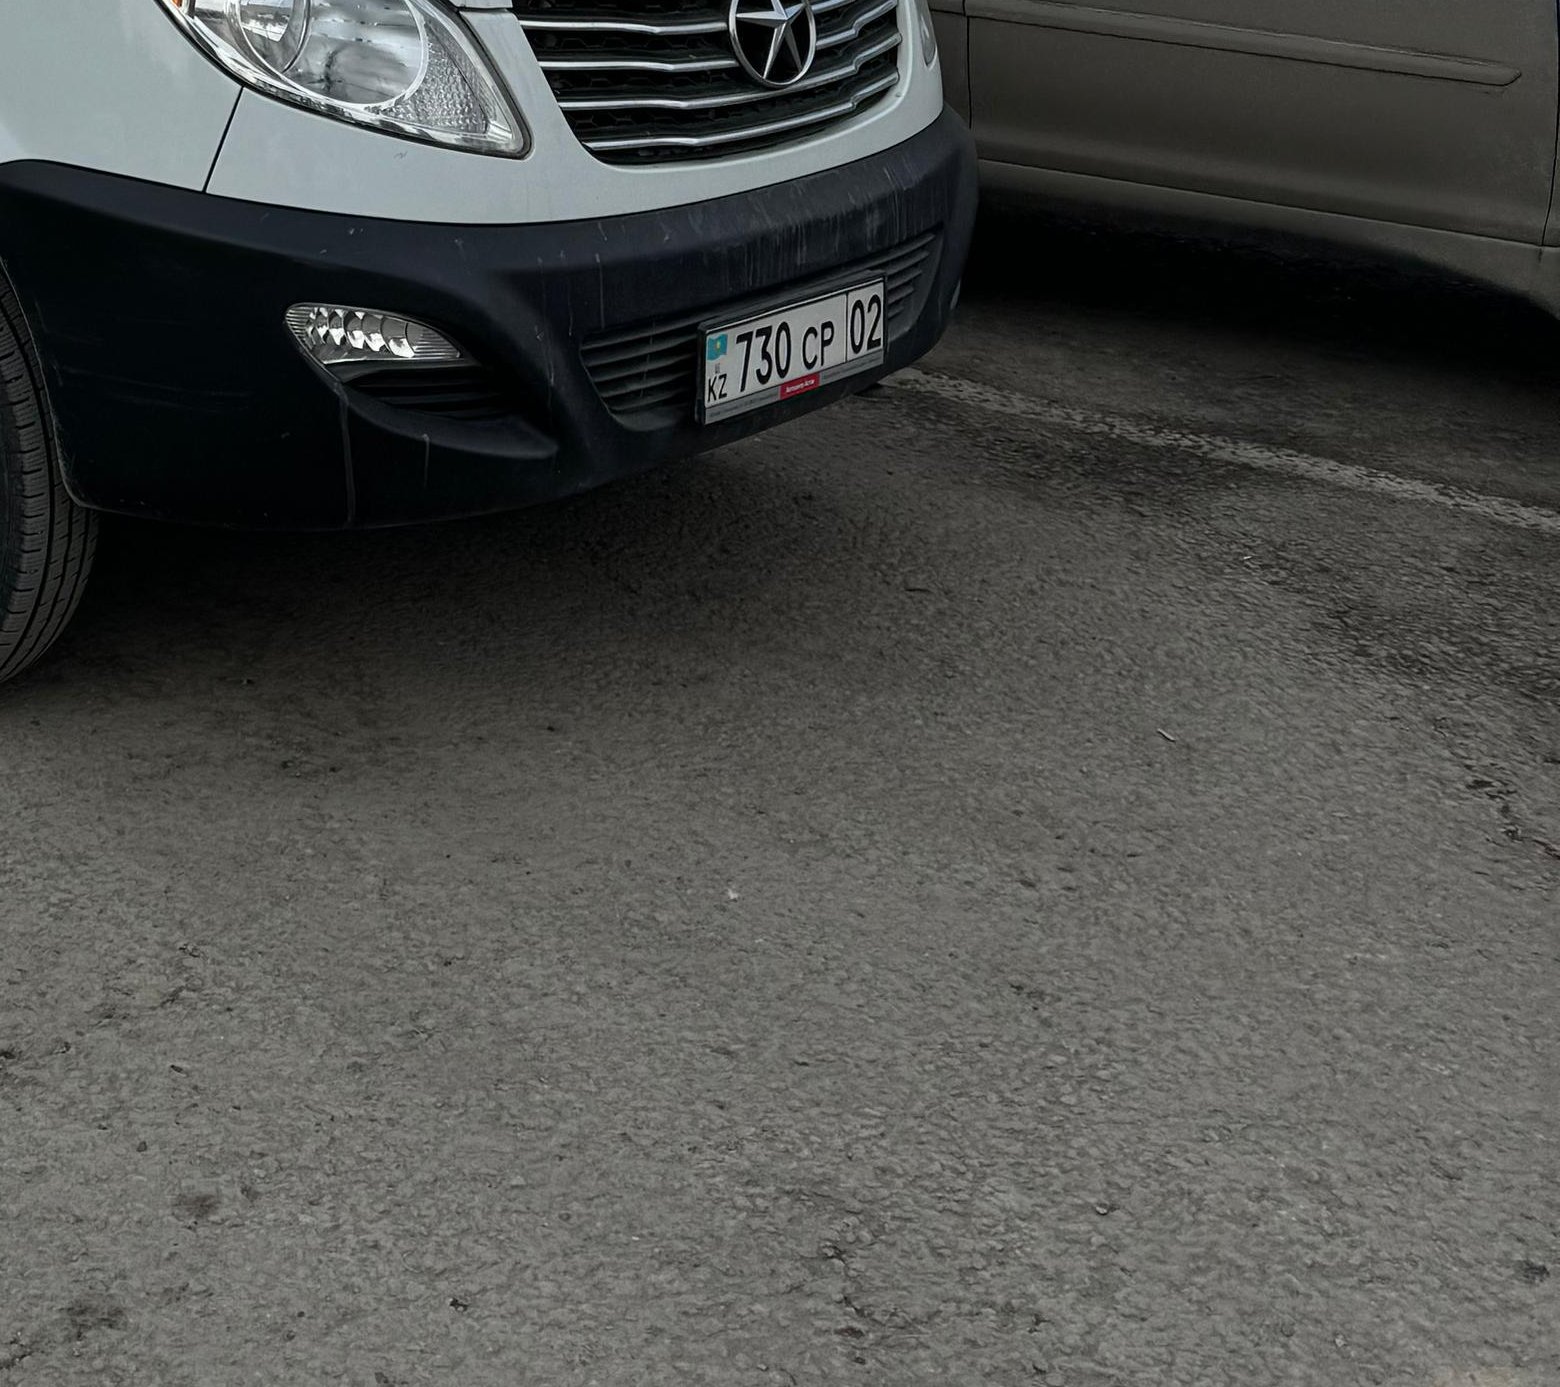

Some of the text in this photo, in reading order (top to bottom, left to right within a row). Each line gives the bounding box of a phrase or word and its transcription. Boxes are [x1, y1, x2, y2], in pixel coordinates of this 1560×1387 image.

[707, 373, 728, 403] KZ
[736, 321, 791, 392] 730
[802, 320, 835, 370] CP
[850, 294, 883, 355] 02
